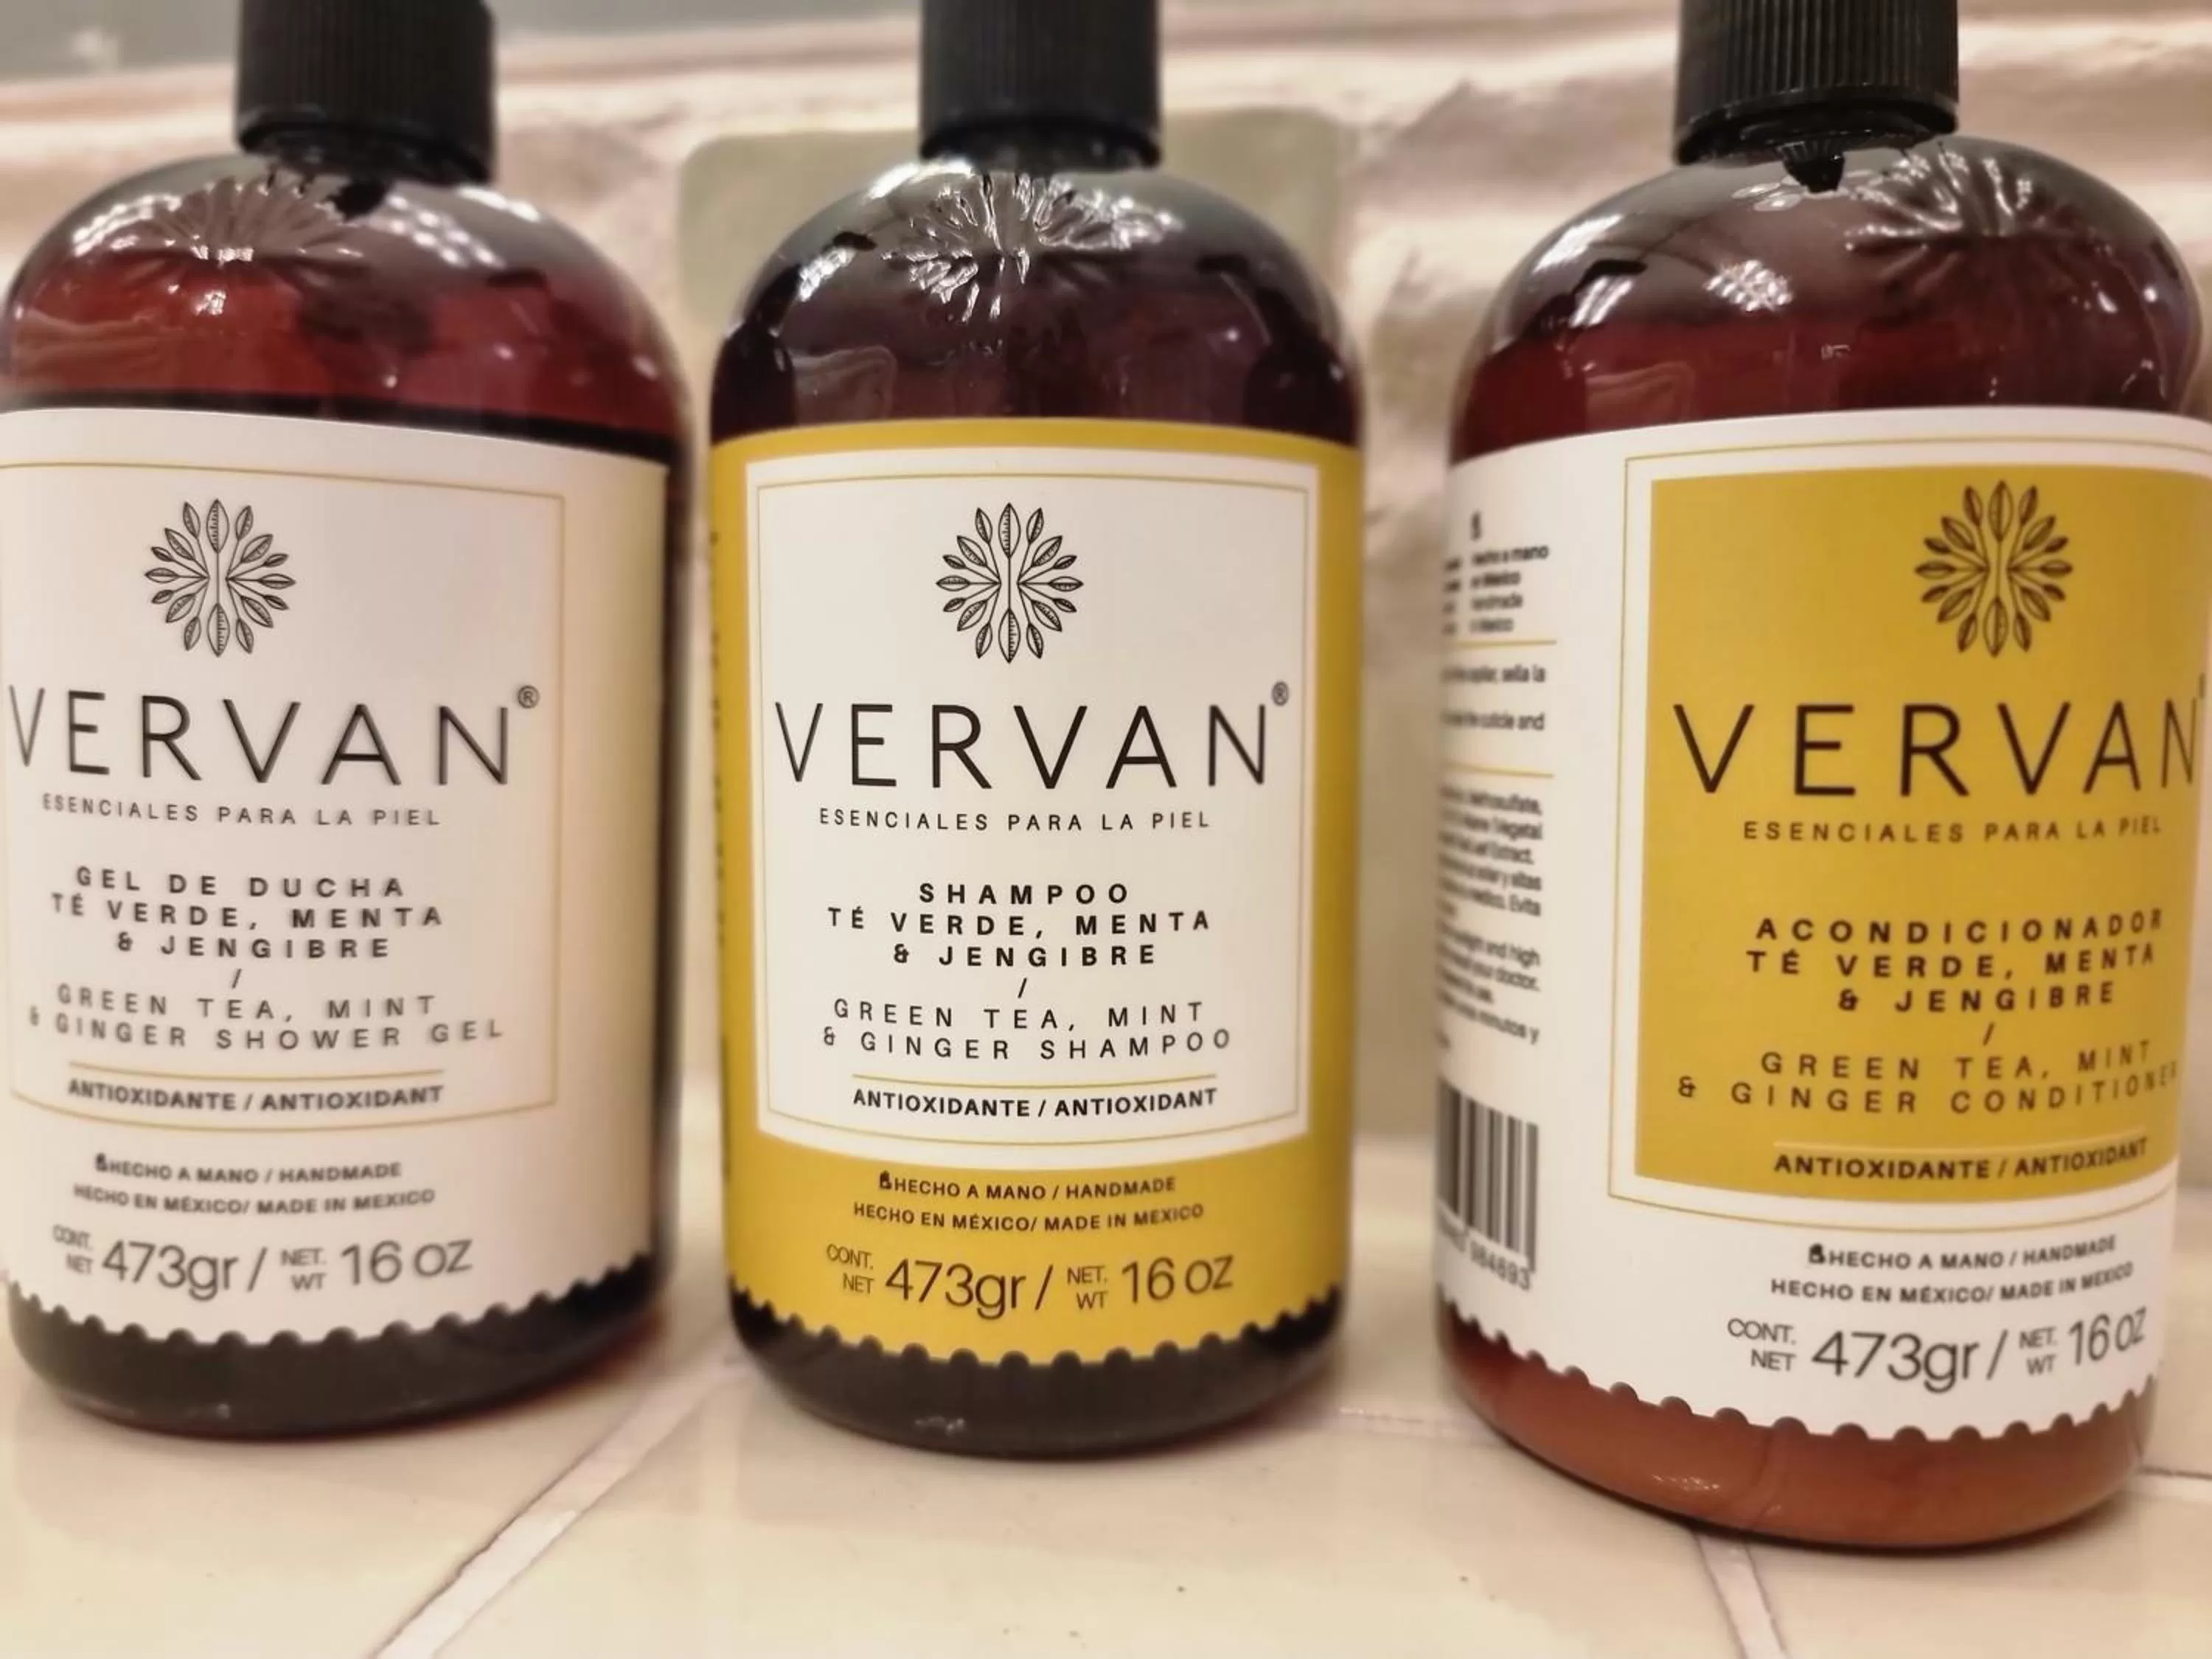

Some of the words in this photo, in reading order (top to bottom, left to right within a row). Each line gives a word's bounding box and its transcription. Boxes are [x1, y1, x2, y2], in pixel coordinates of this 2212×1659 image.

[1518, 712, 1544, 731] and
[44, 793, 198, 821] ESENCIALES
[218, 807, 295, 824] PARA
[317, 810, 352, 825] LA
[372, 810, 439, 825] PIEL
[821, 808, 987, 830] ESENCIALES
[1009, 815, 1081, 830] PARA
[1102, 814, 1133, 830] LA
[1152, 811, 1208, 829] PIEL
[1744, 821, 1962, 842] ESENCIALES
[1985, 822, 2059, 841] PARA
[2076, 821, 2104, 839] LA
[2119, 815, 2160, 835] PIEL
[77, 866, 140, 891] GEL
[169, 874, 215, 895] DE
[249, 877, 403, 897] DUCHA
[919, 883, 1127, 905] SHAMPOO
[52, 893, 83, 916] TÉ
[108, 900, 256, 930] VERDE,
[291, 907, 440, 928] MENTA
[828, 906, 863, 929] TÉ
[891, 912, 1042, 939] VERDE,
[1077, 911, 1208, 935] MENTA
[1756, 909, 2160, 944] ACONDICIONADOR
[161, 936, 387, 959] JENGIBRE
[939, 945, 1153, 967] JENGIBRE
[1746, 949, 1799, 974] TÉ
[1837, 955, 2011, 979] VERDE,
[2045, 944, 2152, 974] MENTA
[58, 984, 166, 1015] GREEN
[198, 998, 291, 1022] TEA,
[327, 995, 434, 1018] MINT
[1895, 981, 2112, 1012] JENGIBRE
[835, 998, 951, 1026] GREEN
[984, 1009, 1074, 1031] TEA,
[1109, 1002, 1201, 1026] MINT
[56, 1013, 185, 1046] GINGER
[216, 1027, 399, 1050] SHOWER
[429, 1020, 501, 1043] GEL
[861, 1032, 1008, 1060] GINGER
[1040, 1024, 1228, 1060] SHAMPOO
[1761, 1052, 1919, 1080] GREEN
[1956, 1056, 2048, 1079] TEA,
[2078, 1040, 2149, 1071] MINT
[69, 1079, 236, 1110] ANTIOXIDANTE
[260, 1085, 442, 1110] ANTIOXIDANT
[854, 1089, 1029, 1116] ANTIOXIDANTE
[1054, 1088, 1215, 1116] ANTIOXIDANT
[1731, 1082, 1916, 1113] GINGER
[108, 1159, 173, 1181] HECHO
[178, 1168, 190, 1180] A
[196, 1168, 259, 1183] MANO
[279, 1163, 400, 1183] HANDMADE
[1774, 1155, 1989, 1179] ANTIOXIDANTE
[2014, 1137, 2146, 1177] ANTIOXIDANT
[74, 1185, 130, 1206] HECHO
[133, 1194, 157, 1209] EN
[257, 1199, 316, 1214] MADE
[324, 1198, 346, 1212] IN
[352, 1189, 434, 1211] MEXICO
[895, 1178, 960, 1197] HECHO
[967, 1184, 978, 1198] A
[987, 1185, 1046, 1200] MANO
[1066, 1177, 1174, 1199] HANDMADE
[855, 1203, 914, 1224] HECHO
[922, 1212, 945, 1227] EN
[1045, 1215, 1099, 1231] MADE
[1107, 1214, 1126, 1228] IN
[1134, 1204, 1203, 1225] MEXICO
[53, 1225, 90, 1248] CONT.
[66, 1253, 93, 1274] NET
[280, 1248, 325, 1266] NET.
[342, 1240, 402, 1285] 16
[827, 1244, 873, 1270] CONT.
[1829, 1251, 1911, 1270] HECHO
[1919, 1254, 1932, 1268] A
[1941, 1252, 2003, 1269] MANO
[2023, 1236, 2115, 1265] HANDMADE
[102, 1240, 239, 1301] 473gr
[291, 1273, 326, 1290] WT
[844, 1273, 874, 1294] NET
[1068, 1265, 1107, 1284] NET.
[1122, 1257, 1175, 1304] 16
[1771, 1279, 1854, 1301] HECHO
[1862, 1286, 1891, 1302] EN
[2000, 1281, 2053, 1300] MADE
[2059, 1279, 2076, 1293] IN
[2081, 1262, 2132, 1290] MEXICO
[886, 1259, 1026, 1320] 473gr
[1077, 1291, 1107, 1310] WT
[1728, 1318, 1795, 1344] CONT.
[2020, 1327, 2057, 1349] NET.
[2069, 1314, 2110, 1365] 16
[1751, 1349, 1796, 1371] NET
[1812, 1331, 1979, 1394] 473gr
[2026, 1354, 2056, 1375] WT
